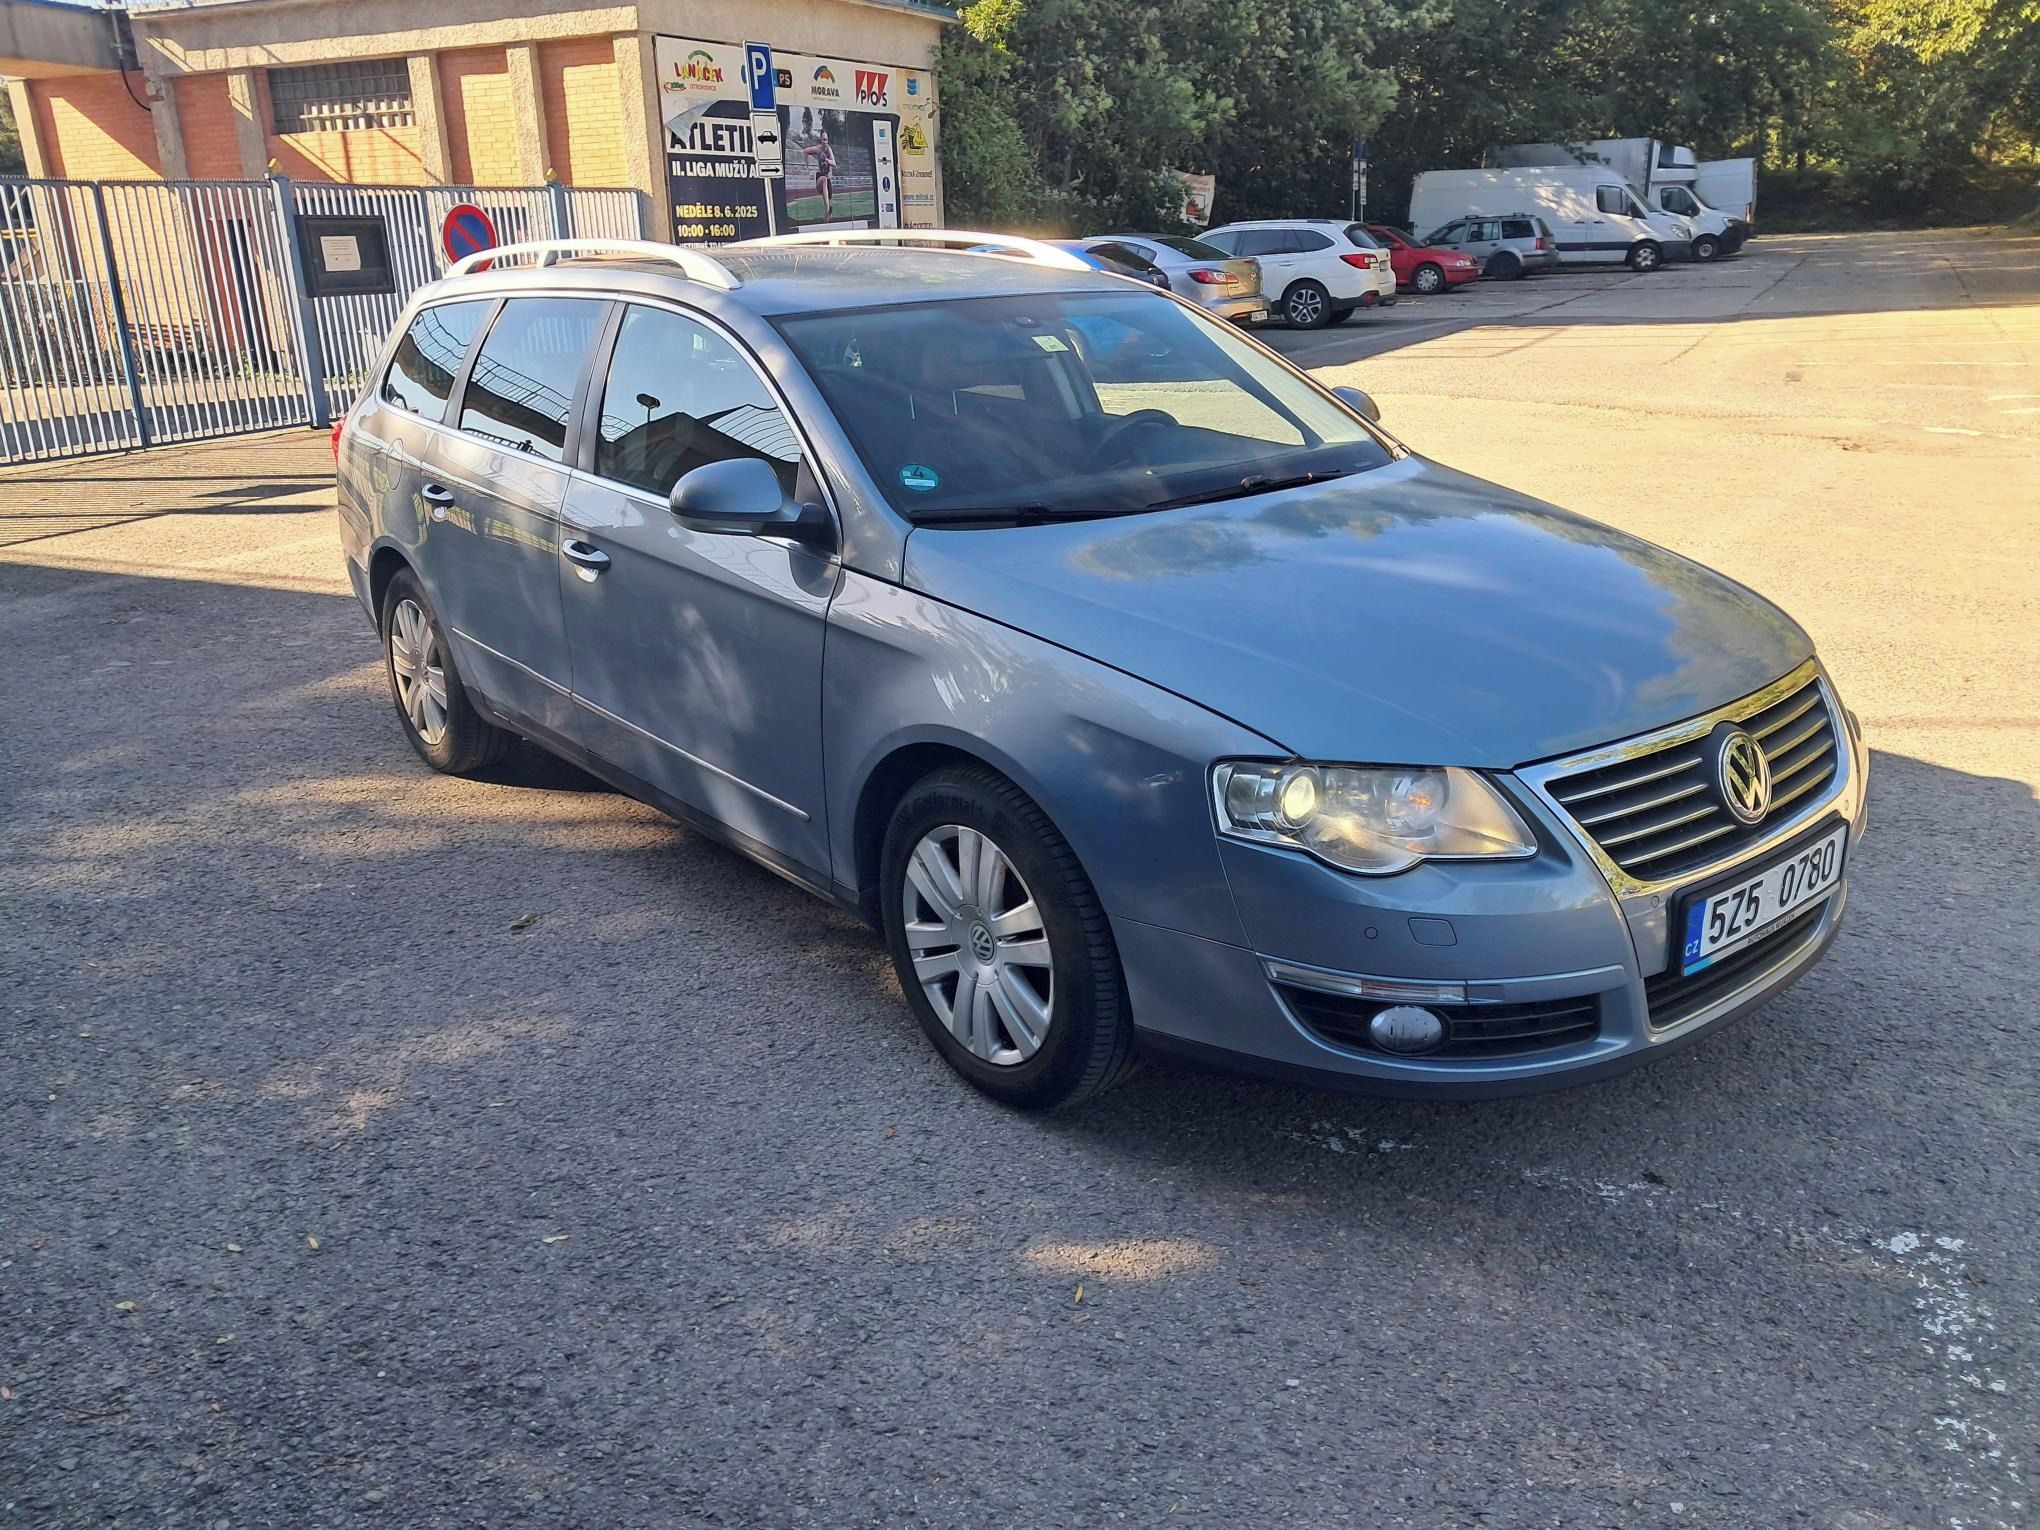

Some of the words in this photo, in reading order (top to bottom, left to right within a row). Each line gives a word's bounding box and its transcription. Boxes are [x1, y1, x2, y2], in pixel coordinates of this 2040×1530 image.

[751, 51, 767, 90] P
[811, 86, 840, 98] MORAVA
[860, 89, 888, 107] POS
[671, 160, 685, 176] II.
[686, 162, 715, 177] LIGA
[715, 159, 748, 178] MUŽŮ
[676, 202, 713, 219] NEDĚLE
[714, 206, 723, 218] 8.
[724, 206, 734, 218] 6.
[735, 205, 758, 218] 2025
[677, 224, 704, 237] 10:00
[709, 224, 736, 237] 16:00
[1708, 879, 1765, 945] 5Z5
[1778, 838, 1836, 908] 0780
[1685, 939, 1699, 957] CZ
